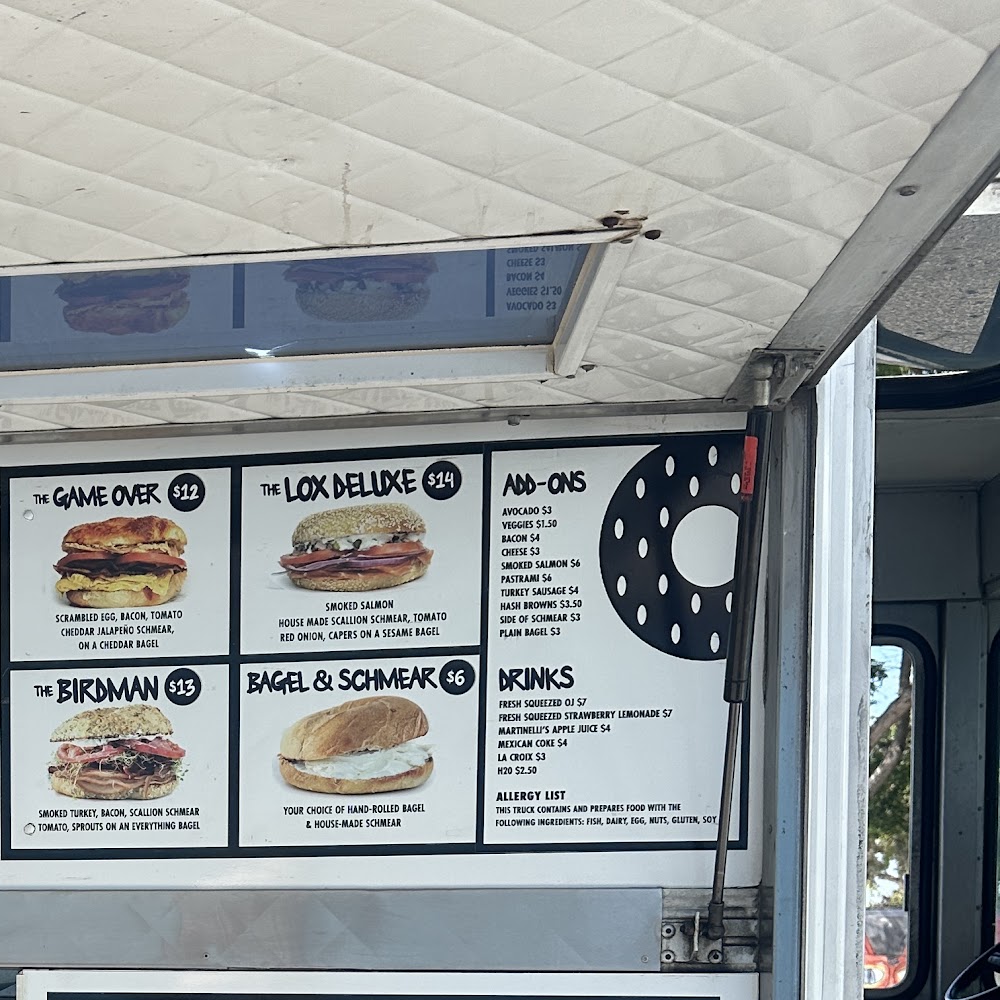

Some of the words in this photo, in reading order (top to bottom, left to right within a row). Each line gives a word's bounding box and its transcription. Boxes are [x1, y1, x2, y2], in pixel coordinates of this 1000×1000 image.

[259, 483, 281, 496] THE
[283, 474, 329, 502] LOX
[332, 468, 417, 499] DELUXE
[427, 471, 454, 488] $14
[502, 470, 586, 496] ADD-ONS
[32, 493, 49, 504] THE
[52, 485, 108, 510] GAME
[111, 482, 161, 506] OVER
[172, 485, 200, 500] $12
[501, 506, 539, 516] AVOCADO
[541, 505, 551, 515] $3
[501, 520, 533, 529] VEGGIES
[535, 519, 557, 529] $1.50
[325, 601, 357, 611] SMOKED
[360, 599, 393, 609] SALMON
[246, 670, 309, 695] BAGEL
[312, 669, 333, 691] &
[337, 665, 437, 691] SCHMEAR
[445, 671, 466, 687] $6
[498, 665, 574, 691] DRINKS
[33, 685, 53, 697] THE
[56, 675, 158, 703] BIRDMAN
[168, 679, 196, 697] $13
[499, 699, 521, 708] FRESH
[524, 698, 562, 707] SQUEEZED
[564, 698, 574, 706] OJ
[576, 697, 587, 707] $7
[497, 739, 532, 748] MEXICAN
[535, 738, 554, 747] COKE
[557, 738, 567, 747] $4
[495, 790, 541, 801] ALLERGY
[545, 790, 565, 800] LIST
